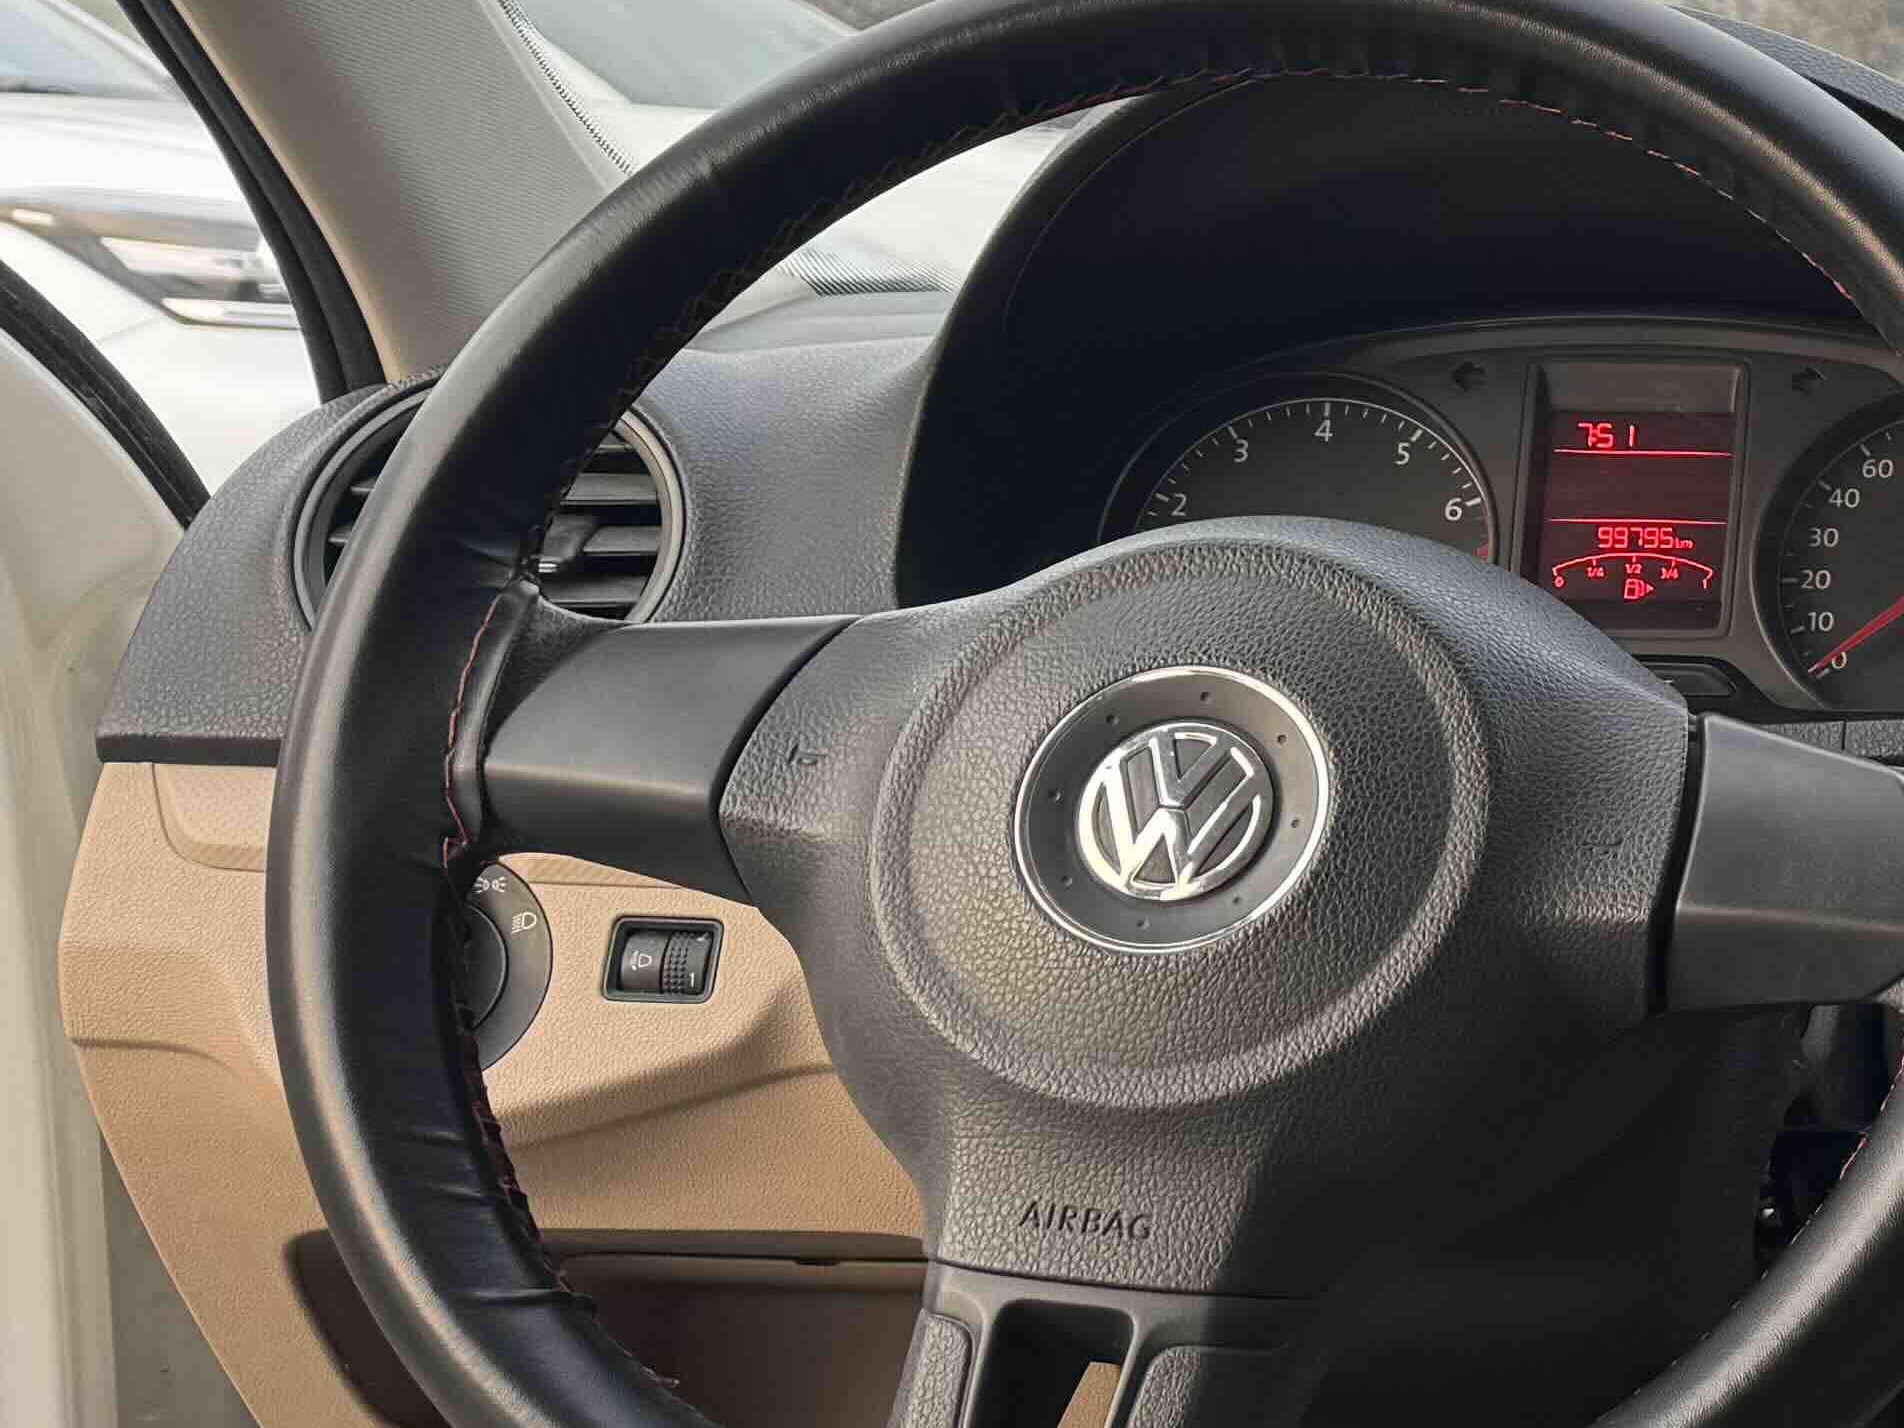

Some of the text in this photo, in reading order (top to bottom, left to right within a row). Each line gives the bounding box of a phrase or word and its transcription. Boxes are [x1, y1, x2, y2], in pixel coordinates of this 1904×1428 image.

[1315, 419, 1333, 442] 4
[1234, 439, 1249, 462] 3
[1396, 442, 1411, 465] 5
[1862, 459, 1894, 478] 60
[1172, 493, 1187, 516] 2
[1444, 497, 1462, 521] 6
[1828, 488, 1860, 508] 40
[1597, 527, 1674, 549] 99795
[1809, 527, 1839, 547] 30
[1800, 570, 1831, 590] 20
[1808, 612, 1835, 632] 10
[1831, 651, 1848, 669] 0
[1018, 1201, 1153, 1240] AIRBAG
